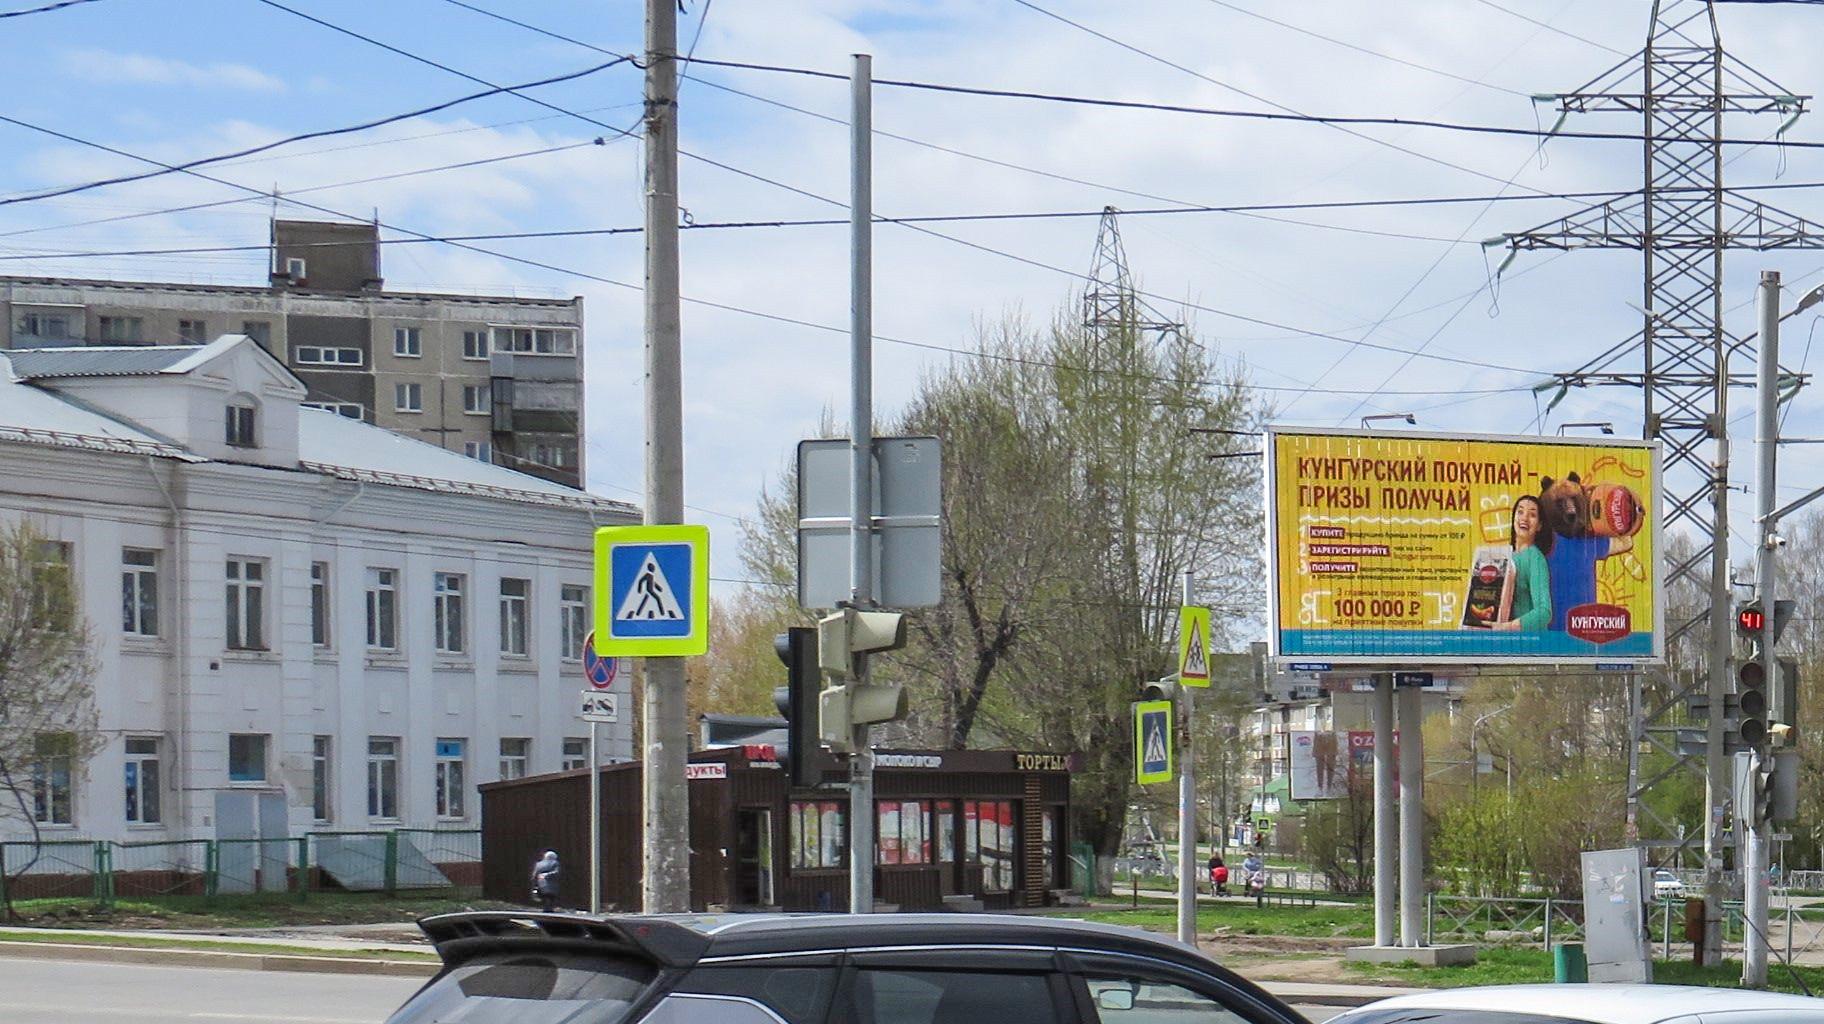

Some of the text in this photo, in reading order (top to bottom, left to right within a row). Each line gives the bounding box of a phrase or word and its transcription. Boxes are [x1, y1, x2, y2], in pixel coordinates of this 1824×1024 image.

[1299, 456, 1426, 482] КУНГУРСКИЙ
[1433, 459, 1522, 485] ПОКУПАЙ
[1299, 485, 1470, 511] ПРИЗЫ ПОЛУЧАЙ
[1311, 529, 1344, 537] КУПИТЕ
[1312, 546, 1387, 555] ЗАРЕГИСТРИРУЙТЕ
[1312, 563, 1356, 572] ПОЛУЧИТЕ
[1334, 599, 1365, 617] 100
[1371, 599, 1404, 617] 000
[1571, 614, 1626, 629] КУНГУРСКИЙ
[1742, 613, 1760, 628] 41
[1017, 755, 1062, 771] ТОРТЫ
